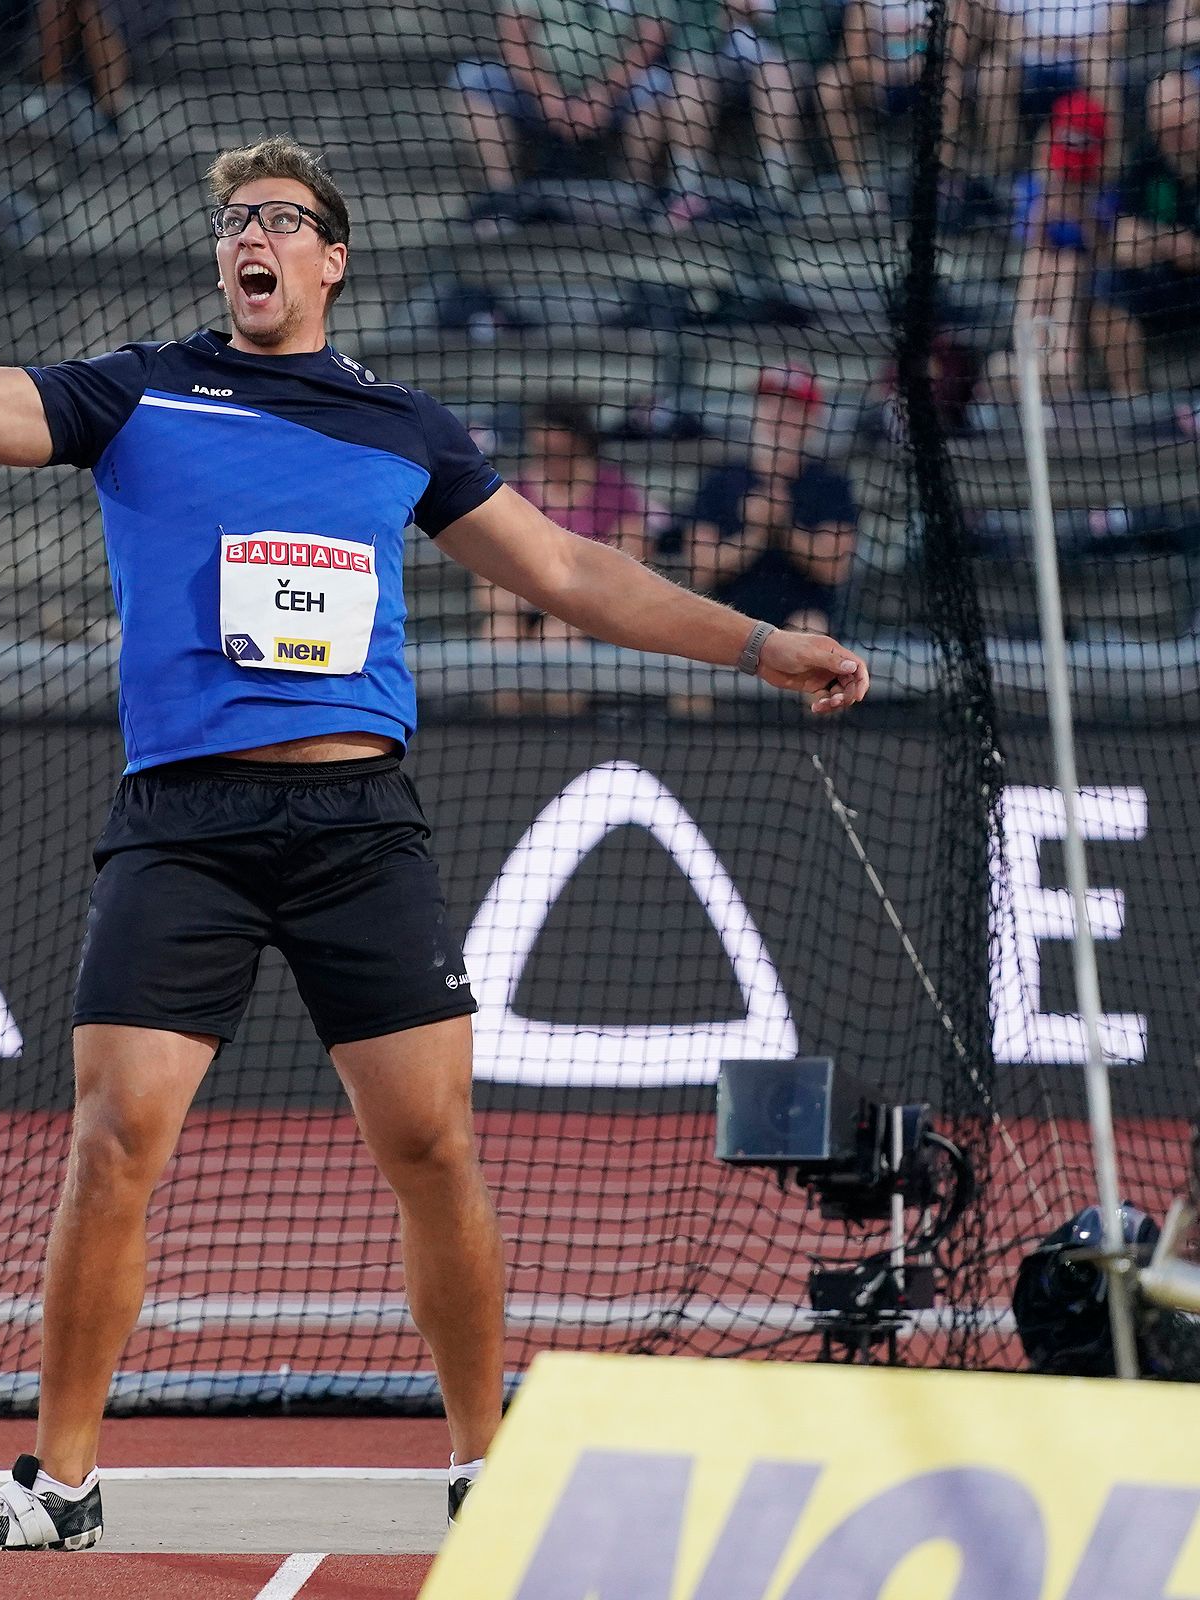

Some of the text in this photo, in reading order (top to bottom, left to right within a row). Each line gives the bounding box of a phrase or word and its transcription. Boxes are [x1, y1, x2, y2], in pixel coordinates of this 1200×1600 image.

[191, 384, 234, 397] JAKO
[227, 541, 370, 573] BAUHAUS
[274, 578, 325, 613] ČEH
